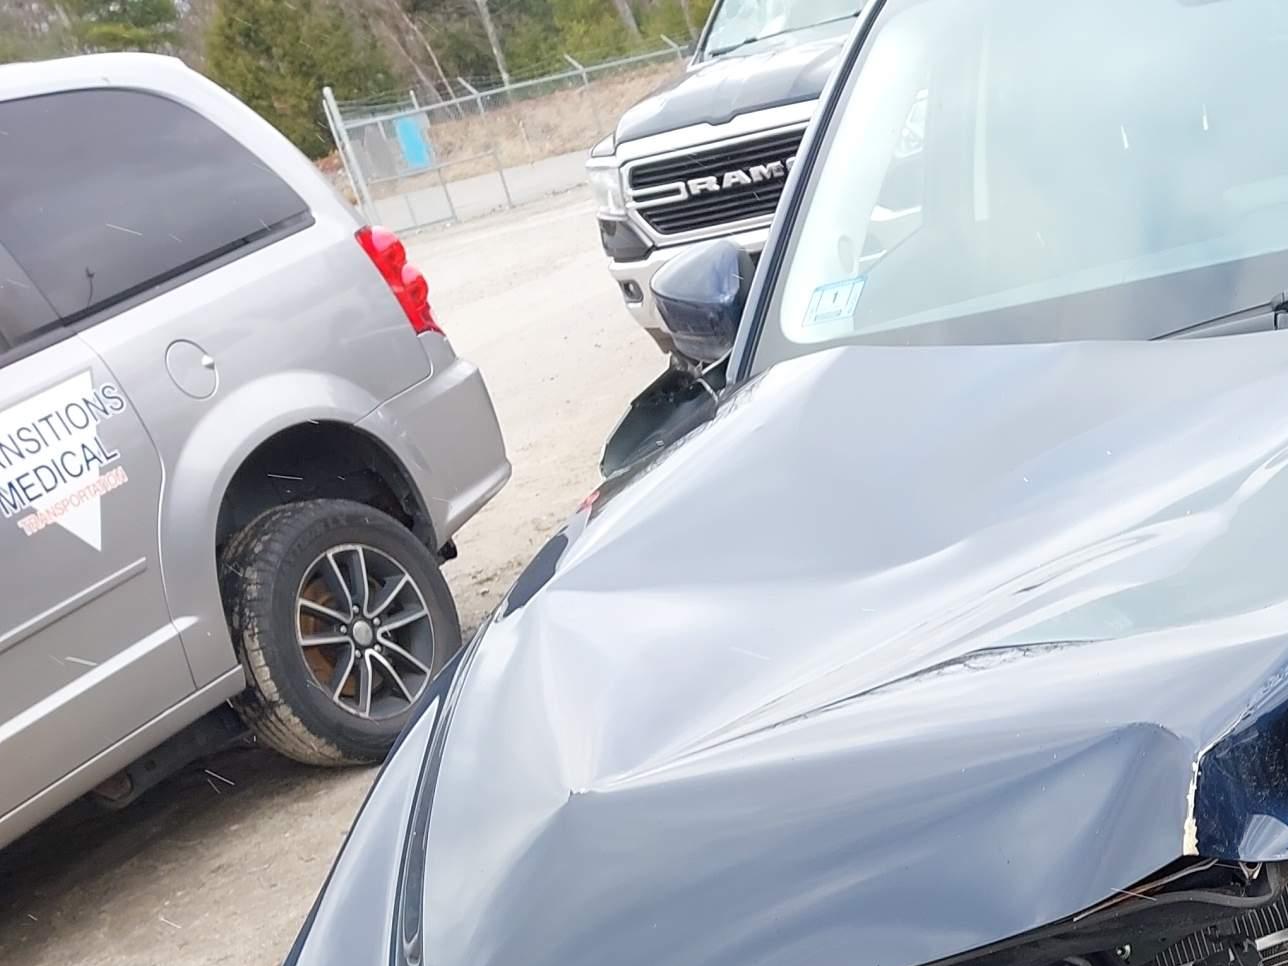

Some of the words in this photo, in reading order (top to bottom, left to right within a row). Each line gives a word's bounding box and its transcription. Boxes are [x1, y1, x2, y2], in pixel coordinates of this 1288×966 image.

[687, 160, 784, 196] RAM
[0, 385, 125, 469] NSITIONS
[0, 437, 119, 515] MEDICAL
[17, 466, 129, 537] TRANSPORTATION
